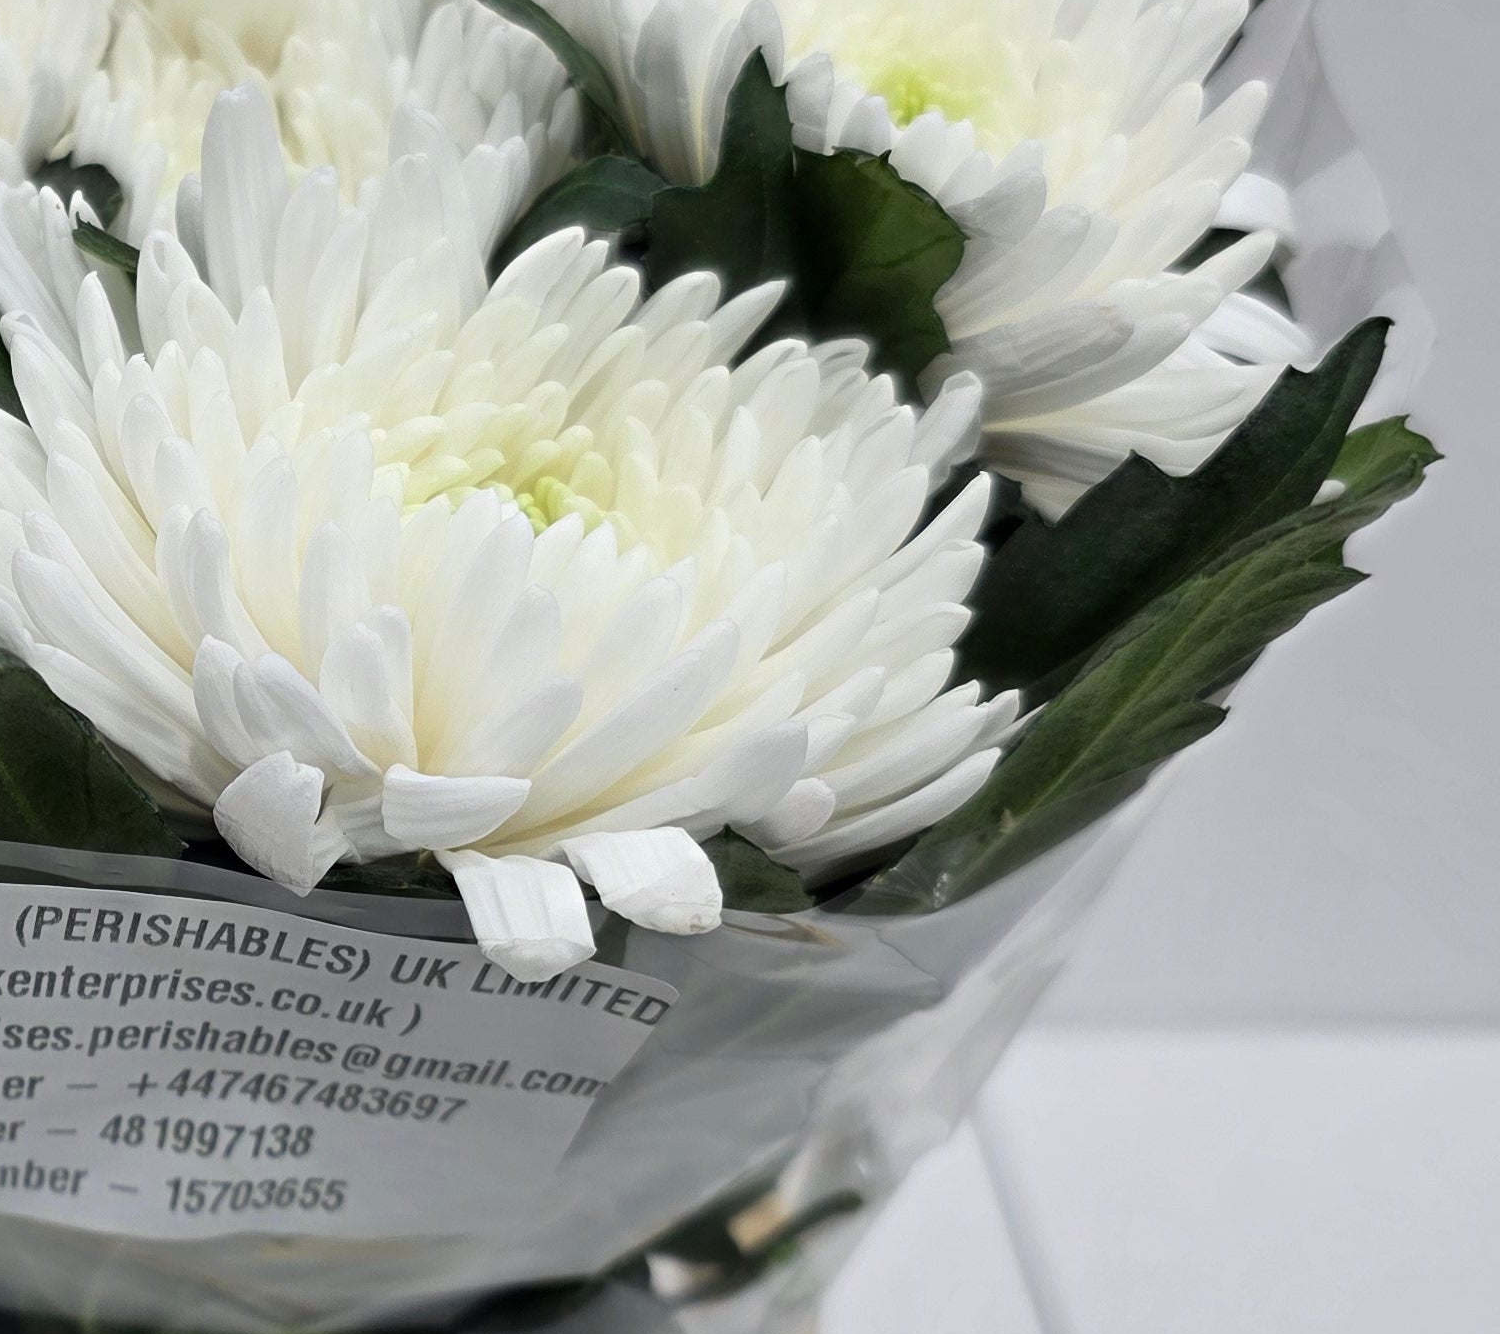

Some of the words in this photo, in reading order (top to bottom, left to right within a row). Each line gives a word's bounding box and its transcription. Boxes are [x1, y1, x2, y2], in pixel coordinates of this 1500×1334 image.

[15, 905, 371, 982] (PERISHABLES)
[389, 953, 460, 989] UK
[100, 1114, 316, 1160] 481997138
[165, 1177, 348, 1215] 15703655
